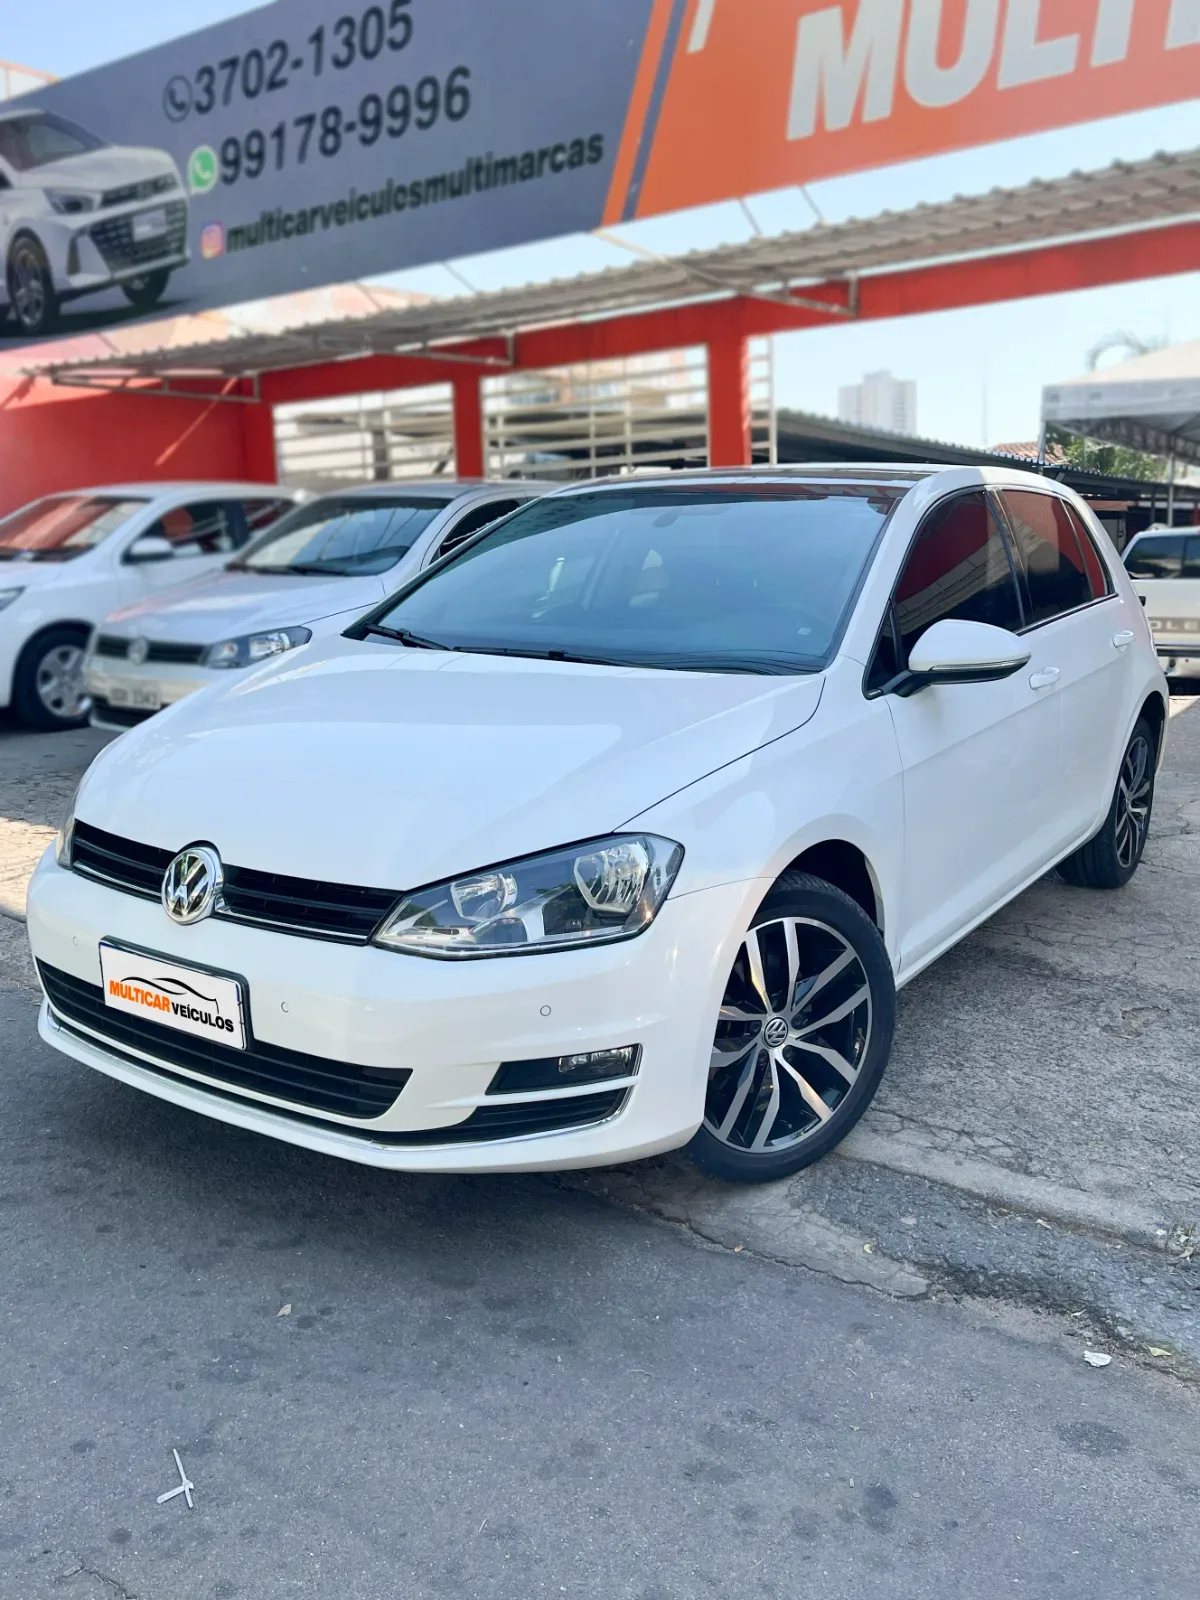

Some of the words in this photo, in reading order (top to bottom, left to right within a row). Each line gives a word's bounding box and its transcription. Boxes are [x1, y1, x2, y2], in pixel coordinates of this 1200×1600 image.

[194, 0, 413, 115] 3702-1305
[220, 65, 471, 186] 99178-9996
[226, 133, 604, 253] multicarveiculosmultimarcas
[109, 979, 171, 1013] MULTICAR
[171, 1002, 234, 1033] VEÍCULOS
